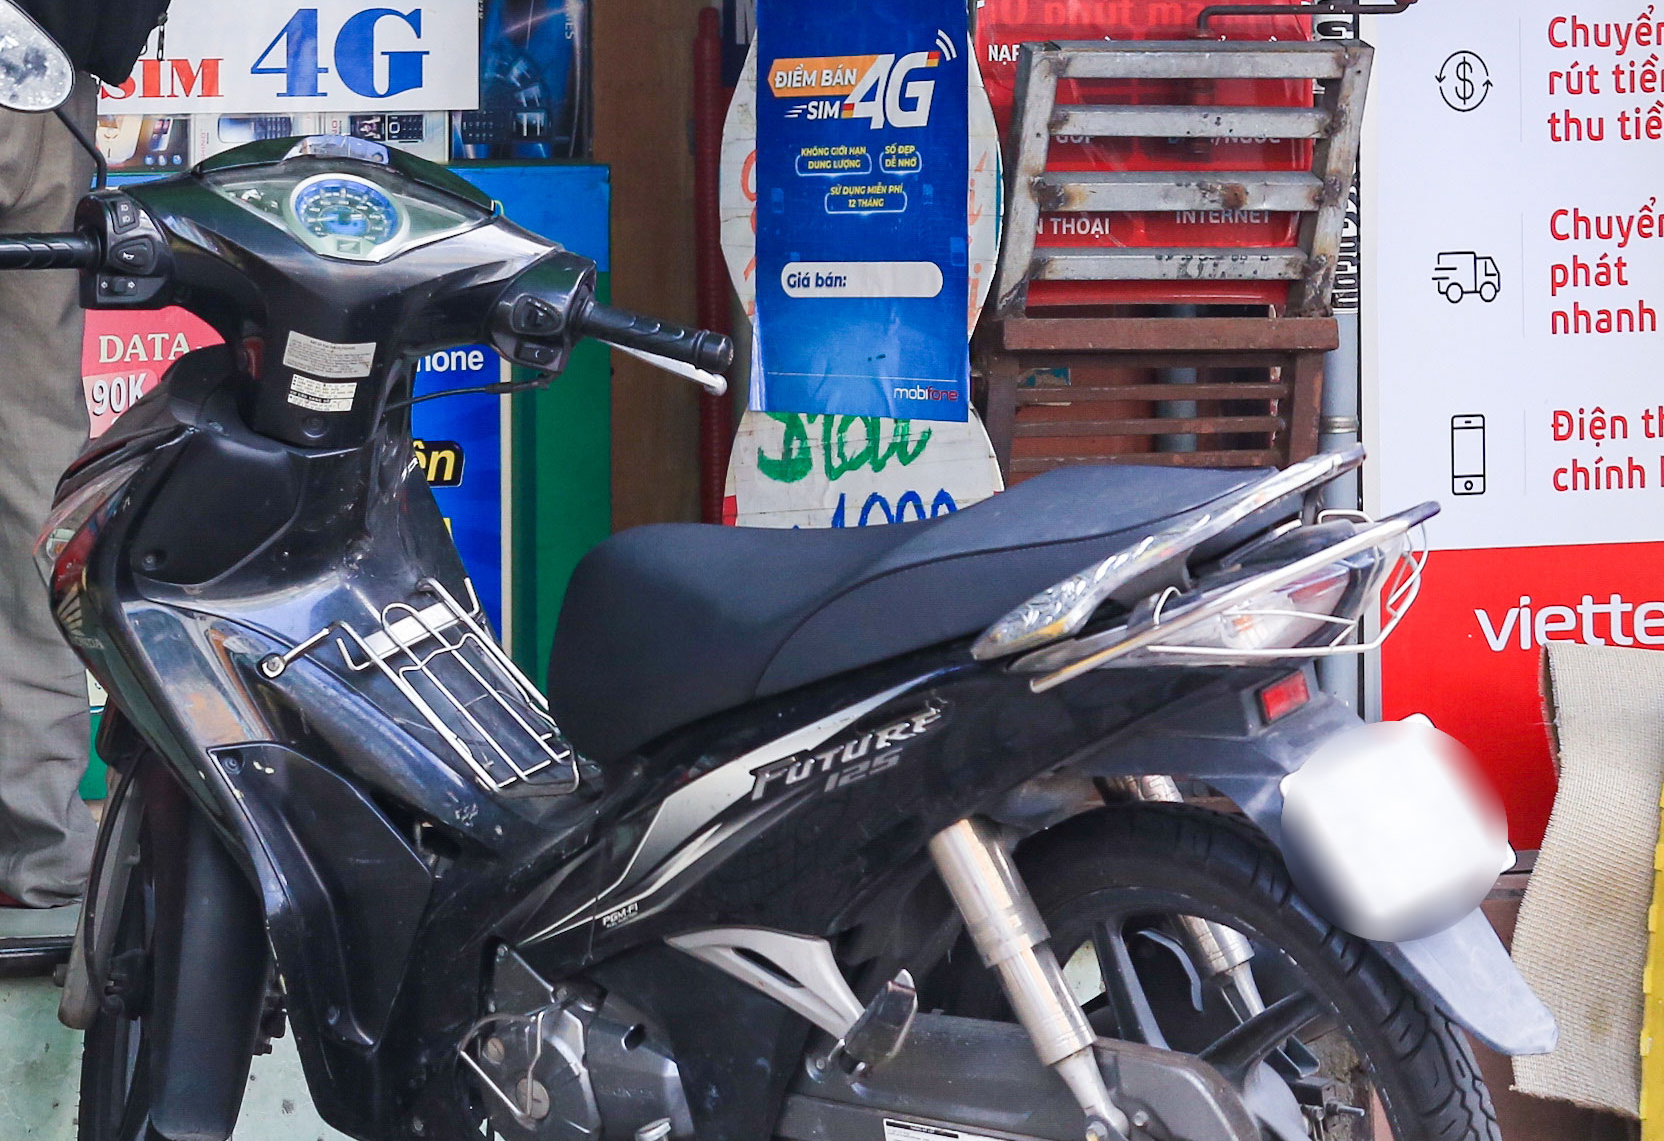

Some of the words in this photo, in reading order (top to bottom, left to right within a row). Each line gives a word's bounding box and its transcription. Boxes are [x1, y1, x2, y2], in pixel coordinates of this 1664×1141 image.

[101, 58, 225, 99] SIM
[251, 8, 430, 99] 4G
[775, 62, 818, 89] ĐIỂM
[821, 66, 856, 87] BÁN
[842, 52, 940, 128] 4G
[1548, 61, 1600, 95] rút
[807, 101, 840, 120] SIM
[1548, 109, 1604, 142] thu
[786, 272, 812, 290] Giá
[816, 272, 846, 288] bán:
[1551, 253, 1628, 296] phát
[1552, 300, 1656, 335] nhanh
[100, 332, 190, 363] DATA
[893, 386, 958, 402] mobifone
[1552, 406, 1628, 447] Điện
[1553, 457, 1646, 491] chính
[751, 707, 941, 801] FUTURE
[825, 749, 900, 793] 125
